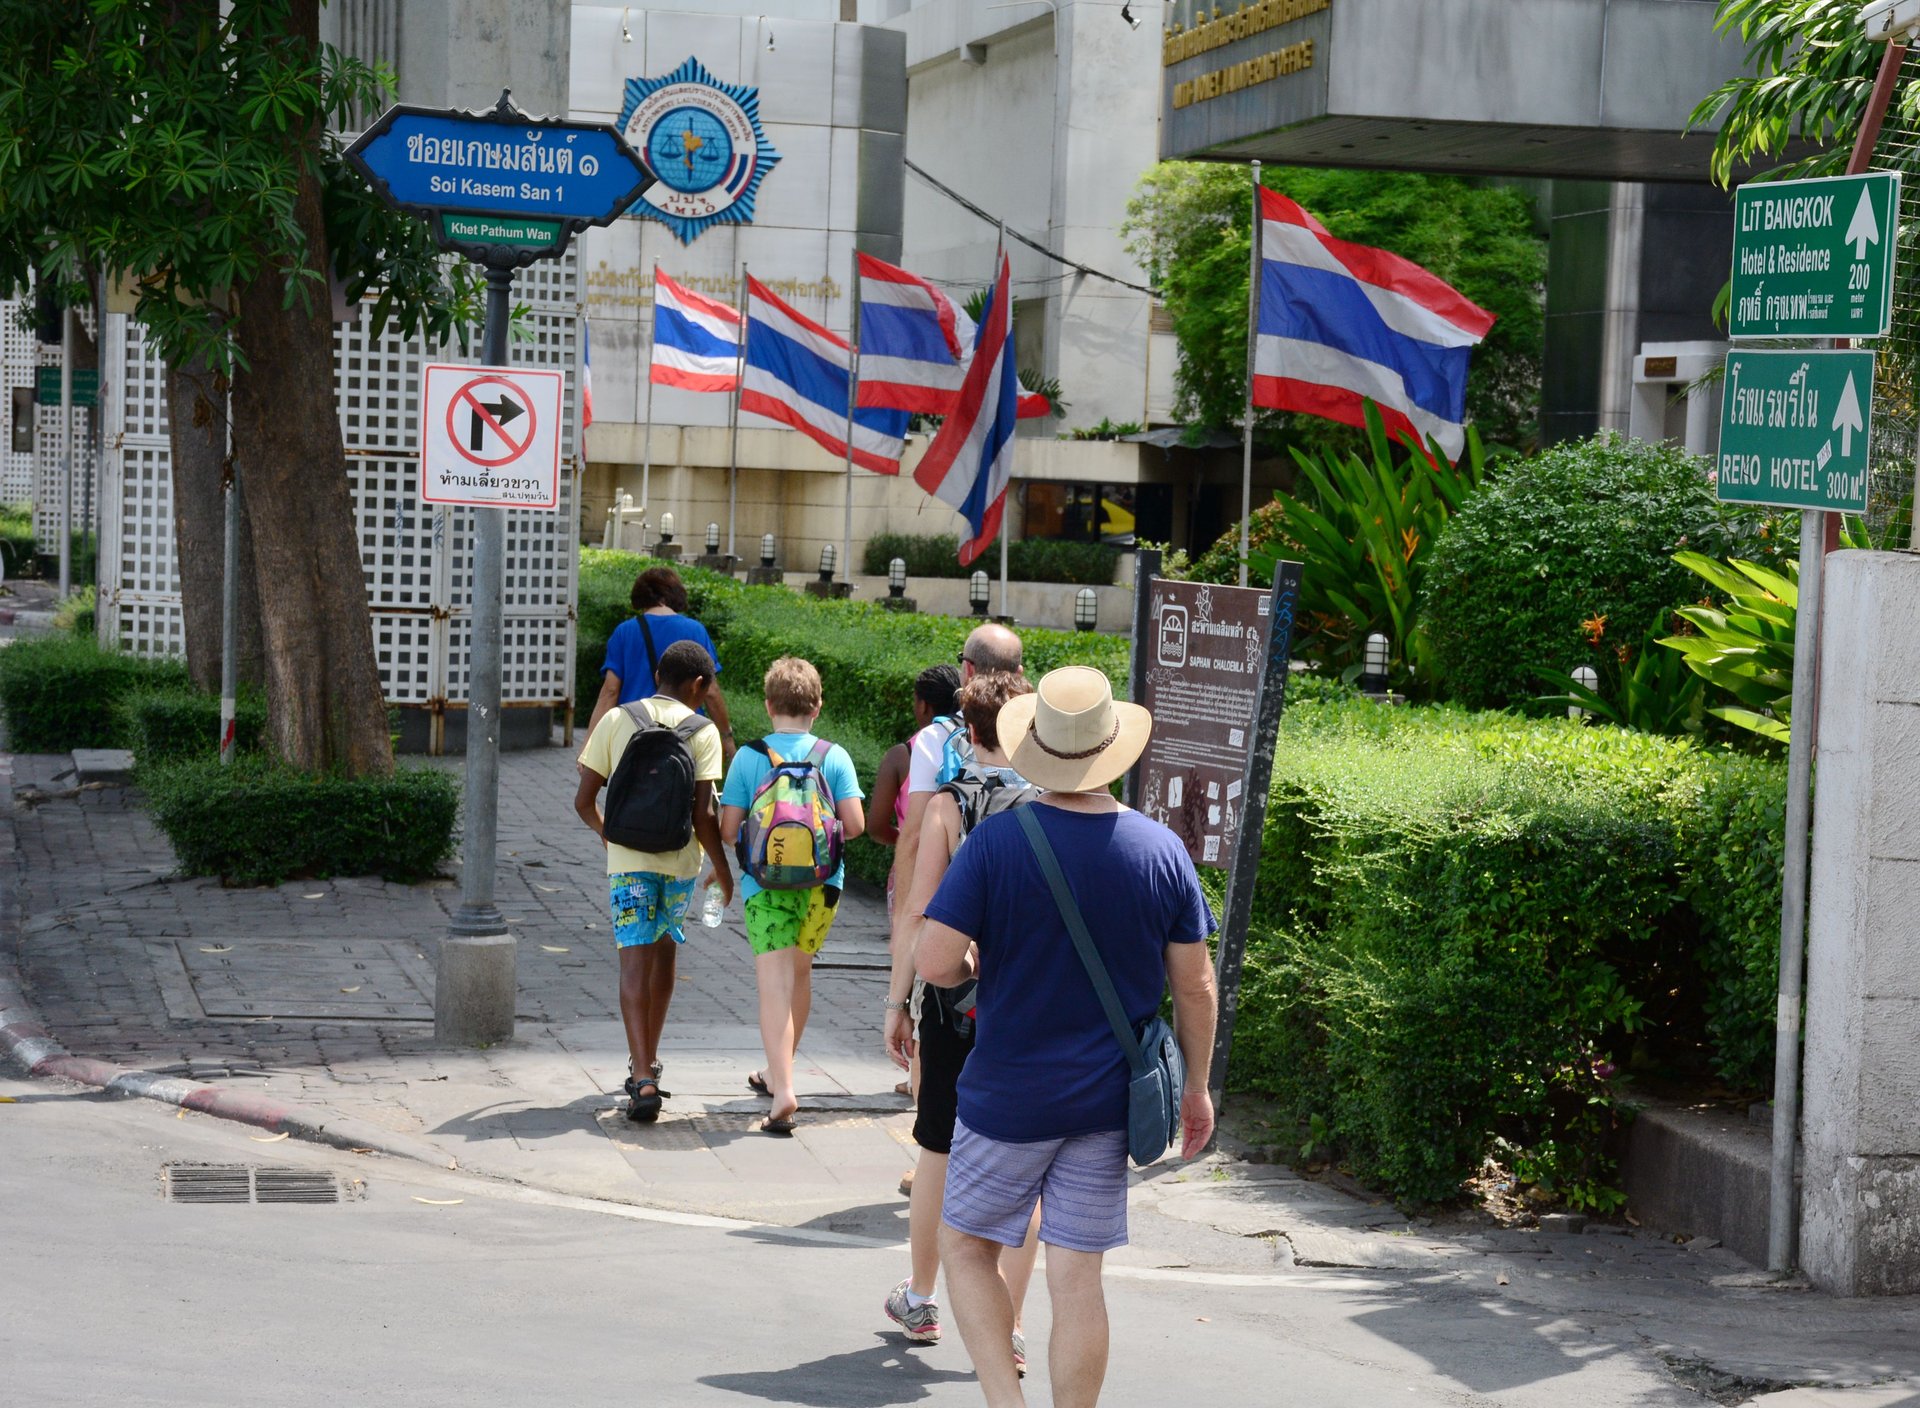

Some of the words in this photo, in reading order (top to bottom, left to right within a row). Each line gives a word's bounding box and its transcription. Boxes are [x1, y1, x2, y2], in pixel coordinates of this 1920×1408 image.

[406, 130, 578, 175] ซอยเกษมสันต์
[578, 154, 600, 177] ๑
[430, 175, 456, 194] Soi
[461, 178, 515, 199] Kasem
[519, 185, 551, 201] San
[555, 185, 564, 202] 1
[659, 202, 716, 216] AMLO
[1741, 201, 1763, 232] LiT
[1764, 195, 1835, 231] BANGKOK
[451, 221, 479, 236] Khet
[480, 224, 524, 239] Pathum
[526, 226, 552, 241] Wan
[1740, 246, 1767, 276] Hotel
[1767, 244, 1776, 275] &
[1777, 242, 1831, 274] Residence
[1848, 263, 1871, 291] 200
[1766, 293, 1808, 332] กรุงเทพ
[1850, 293, 1866, 304] meter
[1730, 361, 1819, 429] โรงแรมรีโน
[439, 467, 541, 490] ห้ามเลี้ยวขวา
[1721, 453, 1761, 486] RENO
[1770, 456, 1819, 492] HOTEL
[1826, 471, 1848, 500] 300
[1189, 655, 1212, 669] SAPHAN
[1213, 658, 1245, 674] CHALOEMLA
